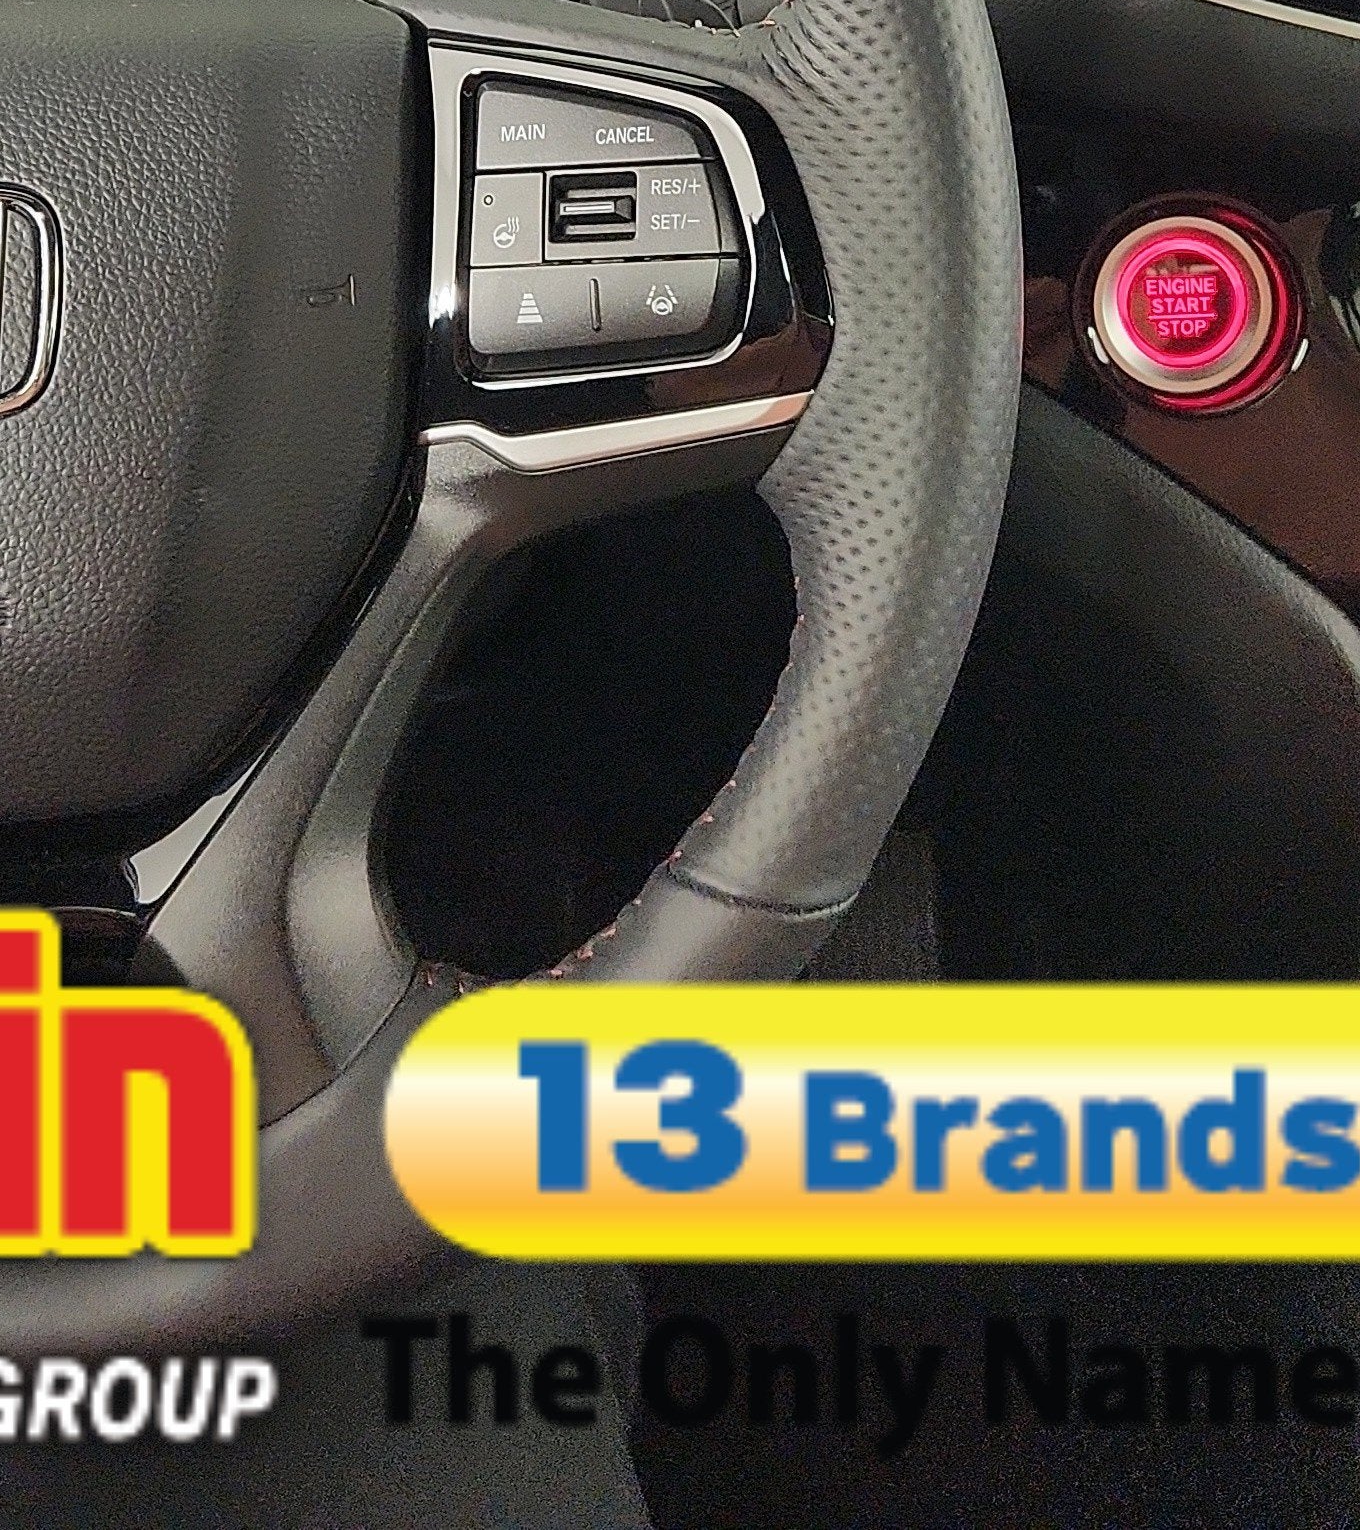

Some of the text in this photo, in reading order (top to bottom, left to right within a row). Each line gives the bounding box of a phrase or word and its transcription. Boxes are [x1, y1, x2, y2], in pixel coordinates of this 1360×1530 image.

[500, 123, 546, 143] MAIN
[595, 126, 655, 146] CANCEL
[650, 178, 702, 197] RES/+
[1145, 277, 1216, 296] ENGINE
[1152, 296, 1211, 315] START
[1157, 320, 1207, 338] STOP
